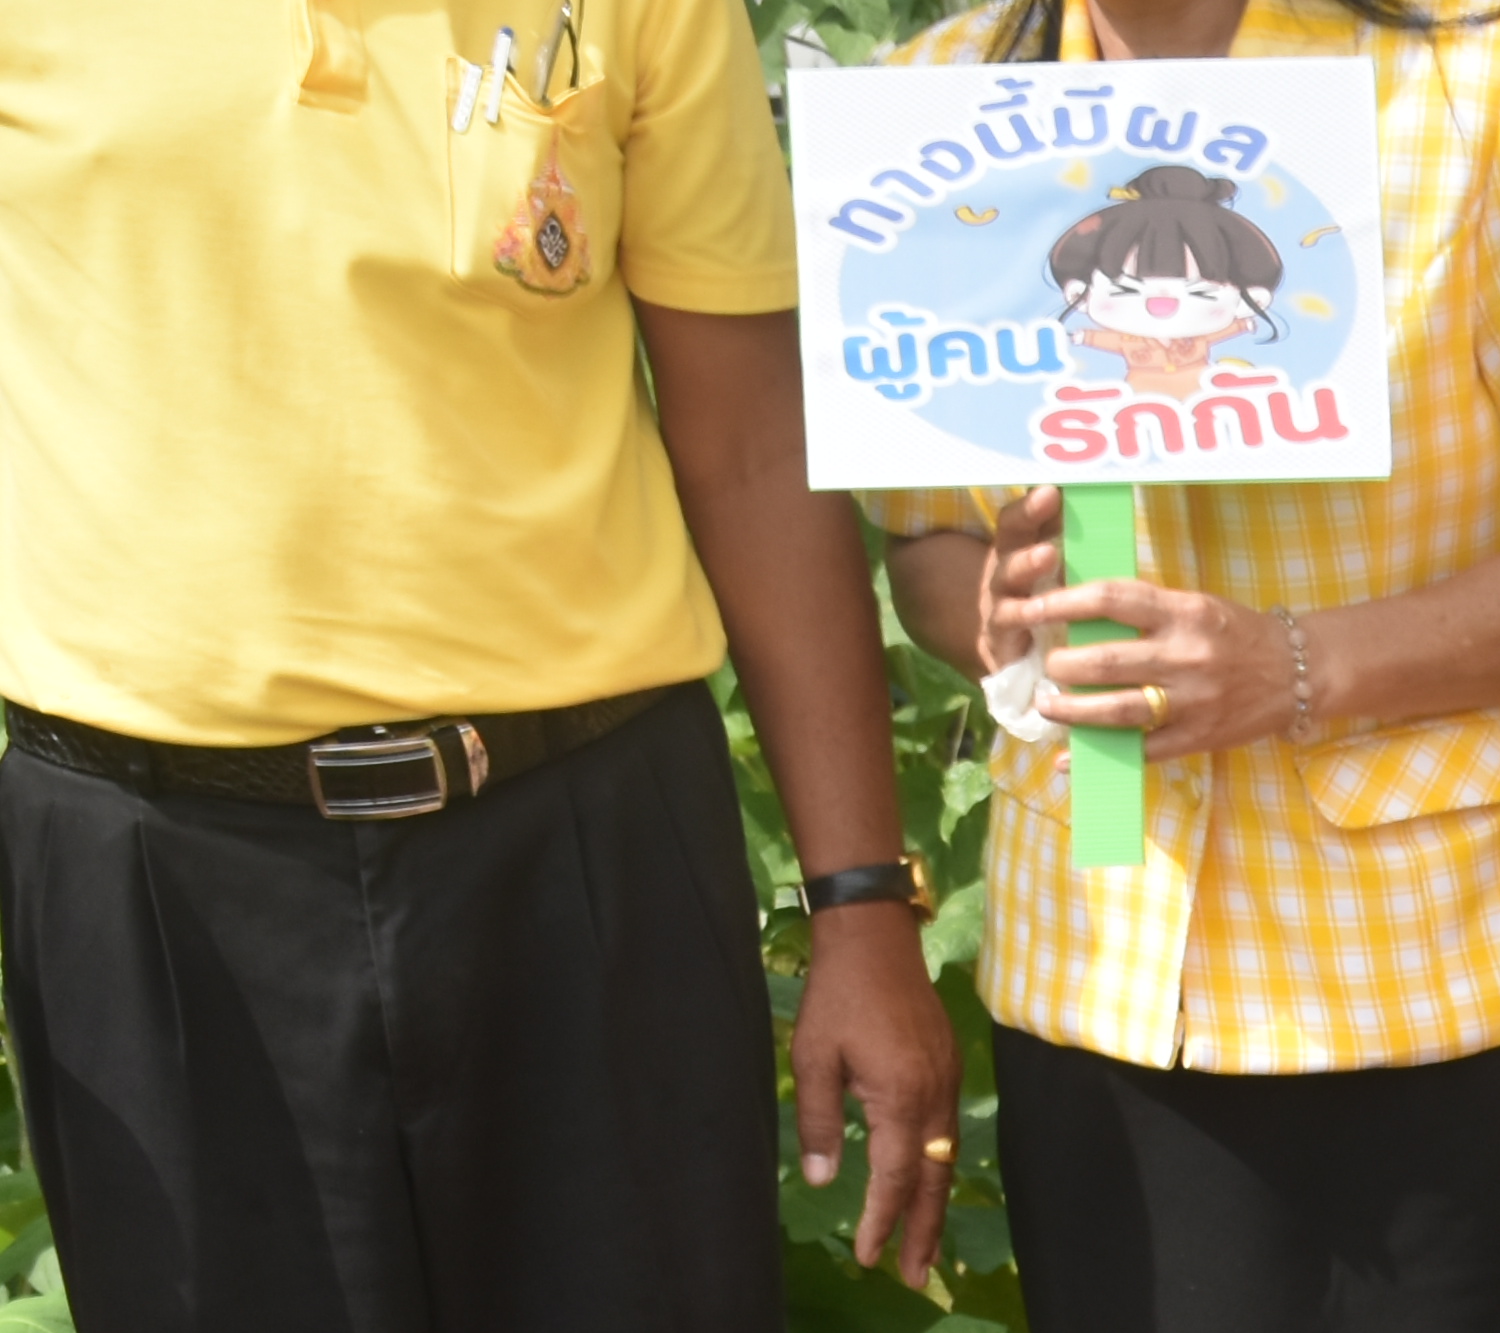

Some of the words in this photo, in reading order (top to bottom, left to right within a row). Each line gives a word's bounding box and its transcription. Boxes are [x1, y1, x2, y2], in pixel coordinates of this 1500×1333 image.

[828, 78, 1268, 245] ทางนี้มีผล
[843, 312, 1065, 401] ผู้คน
[1040, 373, 1349, 463] รักกัน
